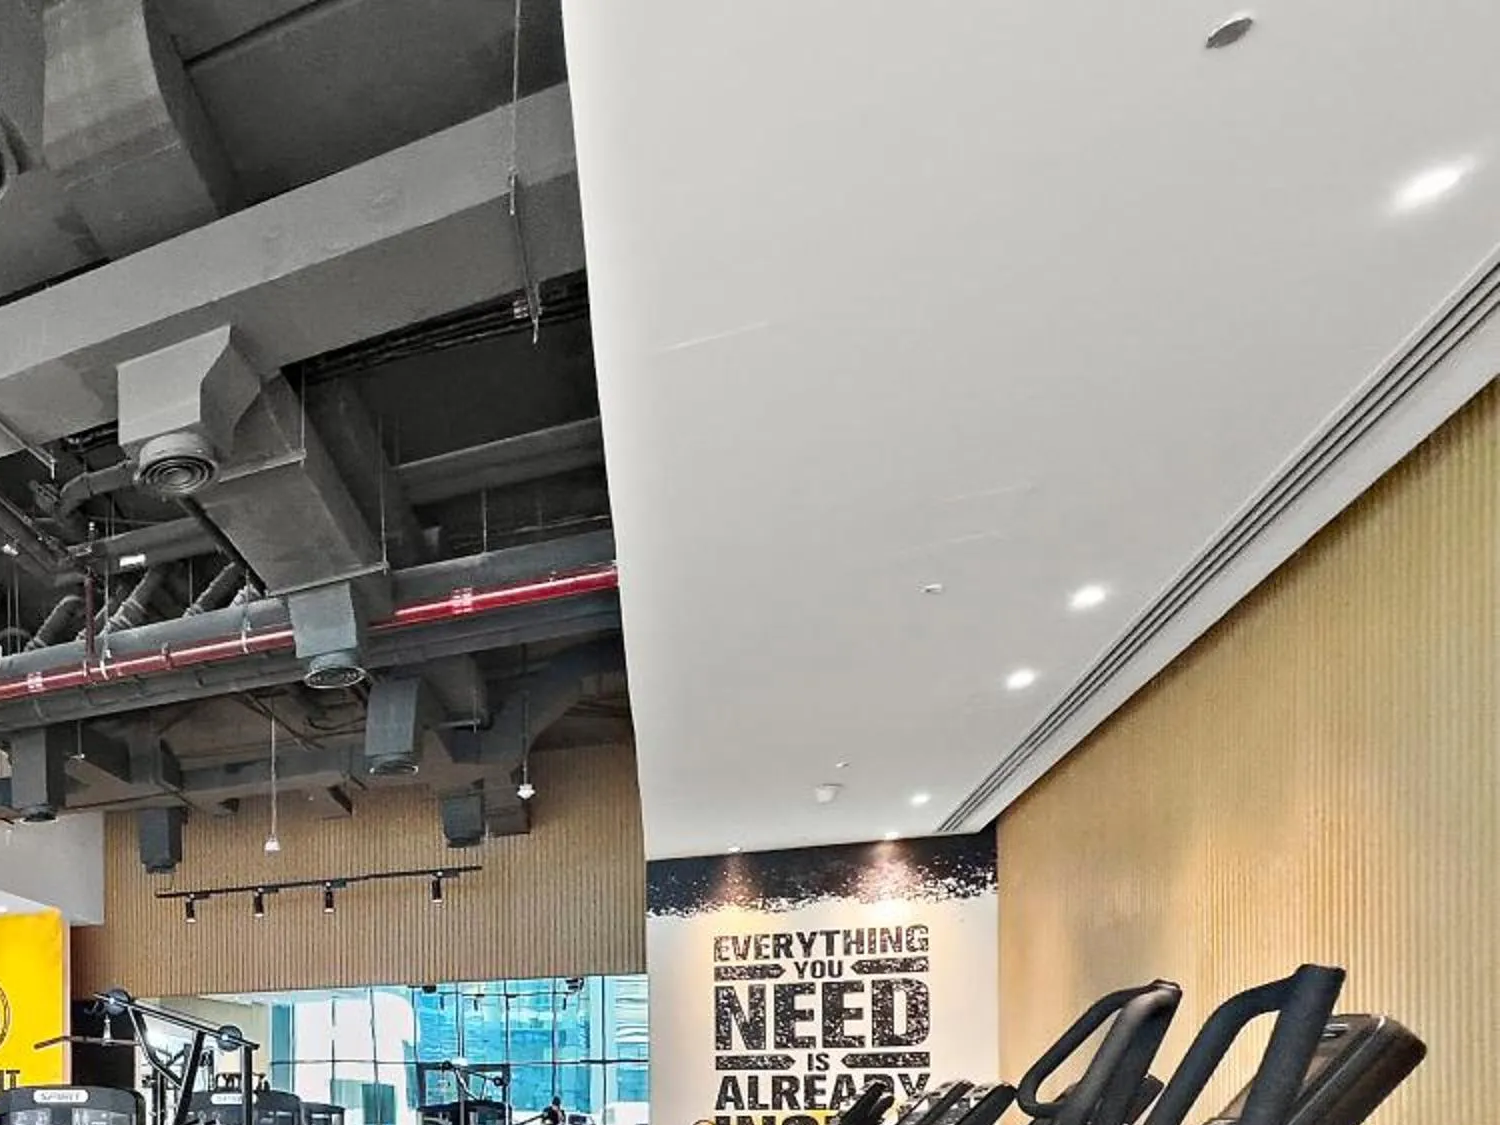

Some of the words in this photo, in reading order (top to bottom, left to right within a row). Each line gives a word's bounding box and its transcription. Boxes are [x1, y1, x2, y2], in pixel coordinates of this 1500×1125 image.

[713, 924, 930, 962] EVERYTHING
[793, 959, 843, 979] YOU
[714, 978, 930, 1051] NEED
[806, 1053, 831, 1072] IS
